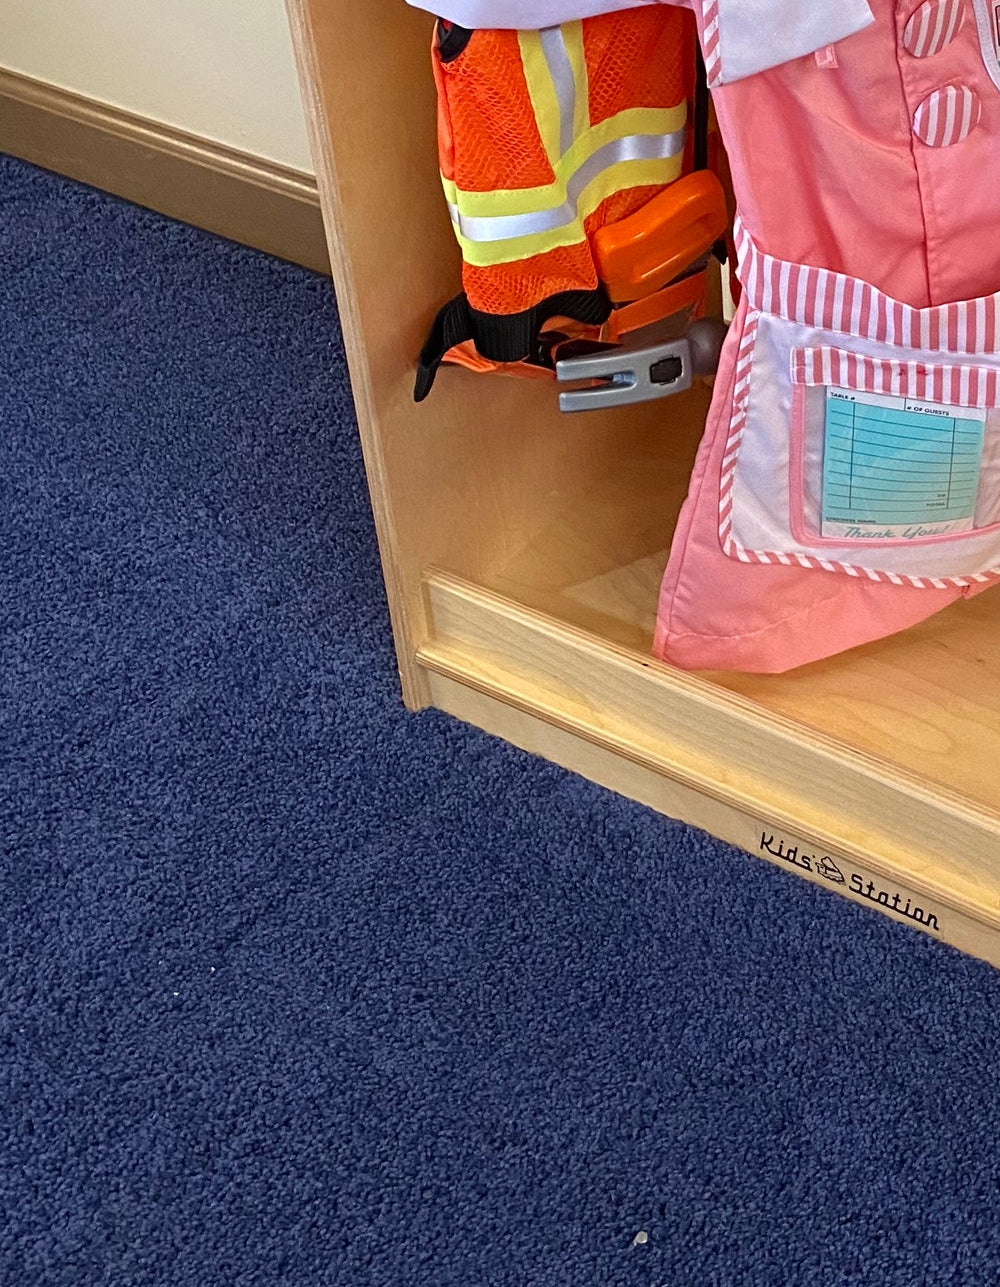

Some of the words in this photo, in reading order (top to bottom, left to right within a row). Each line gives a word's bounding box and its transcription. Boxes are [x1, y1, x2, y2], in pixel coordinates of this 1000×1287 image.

[830, 391, 848, 400] TABLE
[924, 408, 950, 416] GUESTS
[844, 526, 896, 539] Thank
[903, 524, 950, 540] You!
[849, 873, 940, 932] Station
